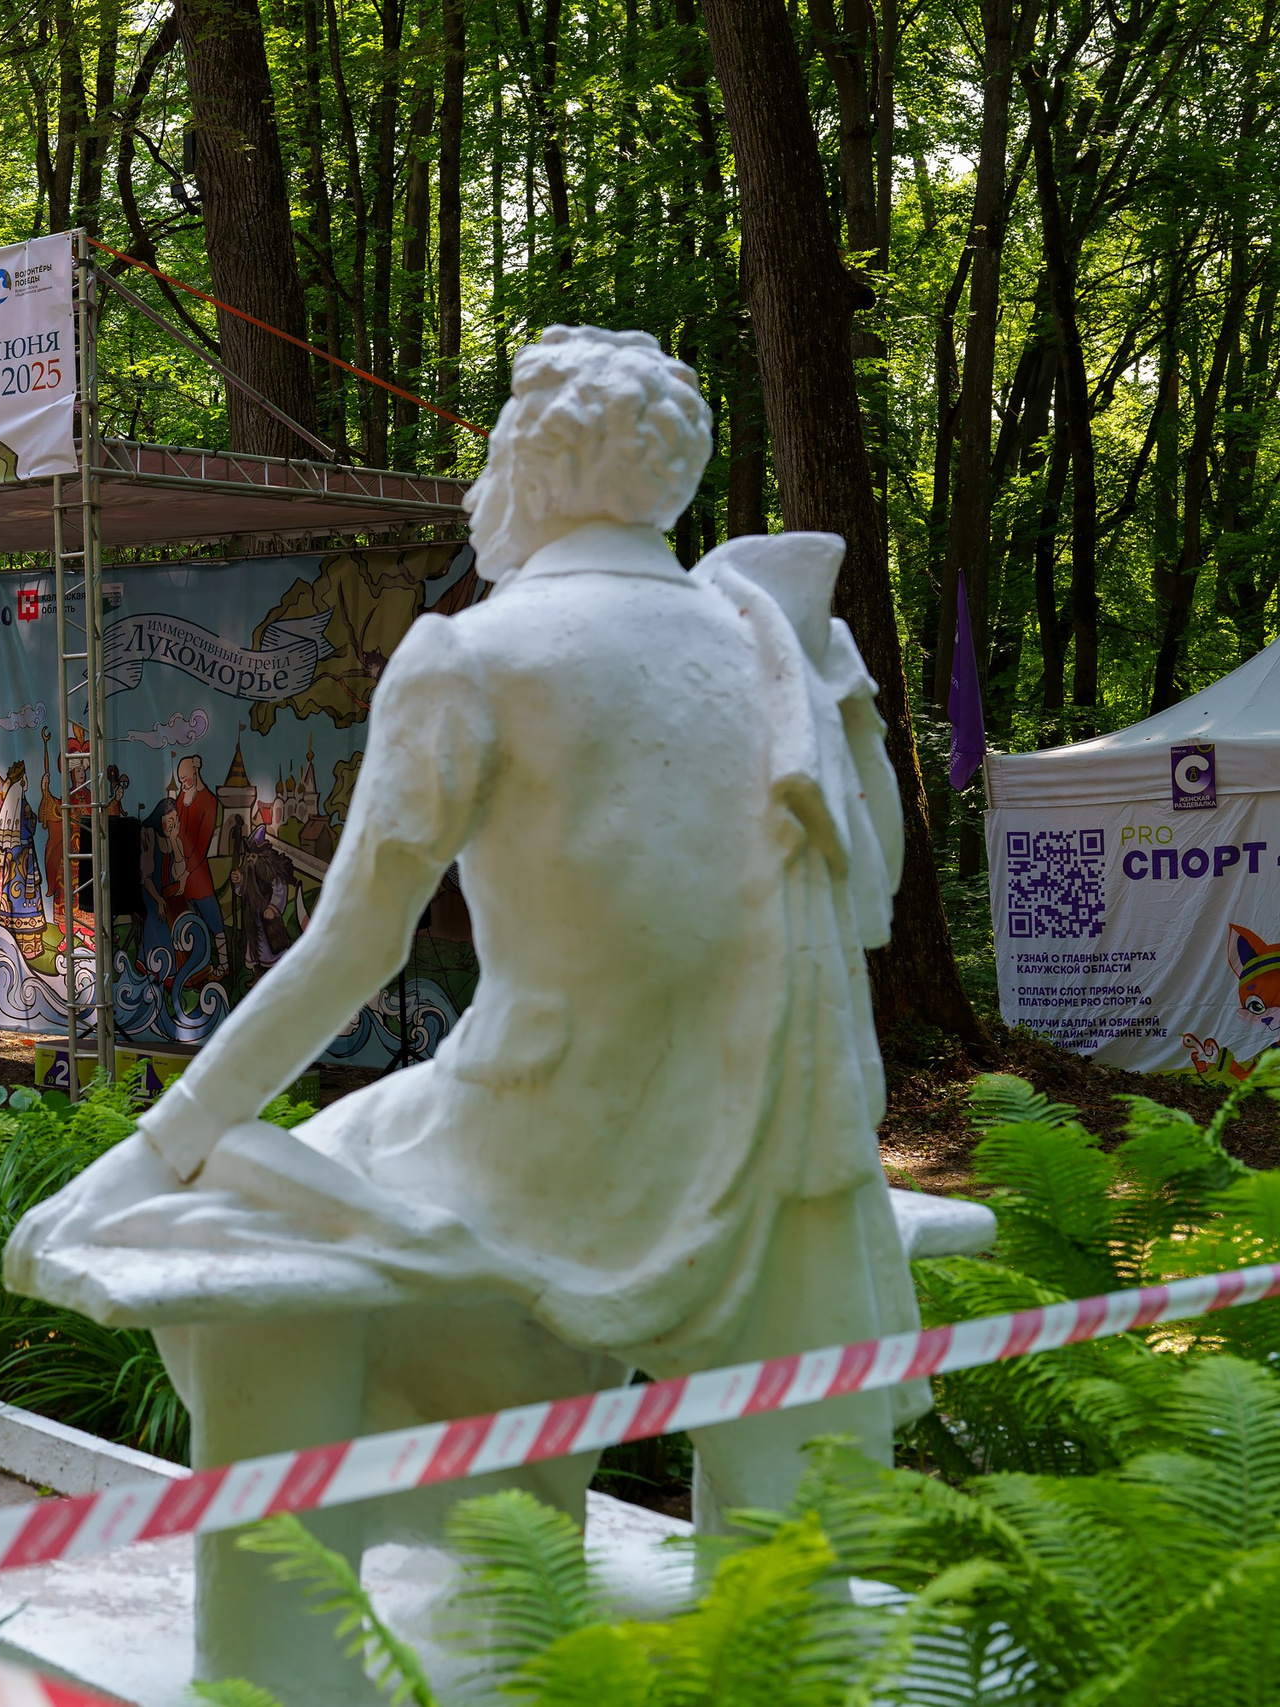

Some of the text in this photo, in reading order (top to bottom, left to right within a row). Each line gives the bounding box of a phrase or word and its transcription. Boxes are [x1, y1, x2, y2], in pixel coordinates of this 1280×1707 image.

[1, 358, 62, 396] 2025
[41, 591, 86, 602] калская
[41, 603, 76, 615] облть
[147, 619, 291, 675] иммерсивный трейл
[123, 624, 289, 699] Лукоморье
[1174, 800, 1216, 809] РАЗДЕВАЛКА
[1179, 795, 1210, 803] ЖЕНСКАЯ
[1121, 826, 1174, 846] PRO
[1122, 841, 1267, 881] СПОРТ
[1016, 951, 1156, 963] УЗНАЙ О ГЛАВНЫХ СТАРТАХ
[1016, 963, 1131, 974] КАЛУЖСКОЙ ОБЛАСТИ
[1018, 985, 1142, 996] ОПЛАТИ СЛОТ ПРЯМО НА
[1018, 996, 1152, 1007] ПЛАТФОРМЕ PRO СПОРТ 40
[1018, 1015, 1160, 1028] ПОЛУЧИ БАЛЛЫ И ОБМЕНЯЙ
[1145, 1028, 1168, 1038] УЖЕ
[1053, 1039, 1098, 1049] ФИНИША
[55, 1059, 69, 1086] 2
